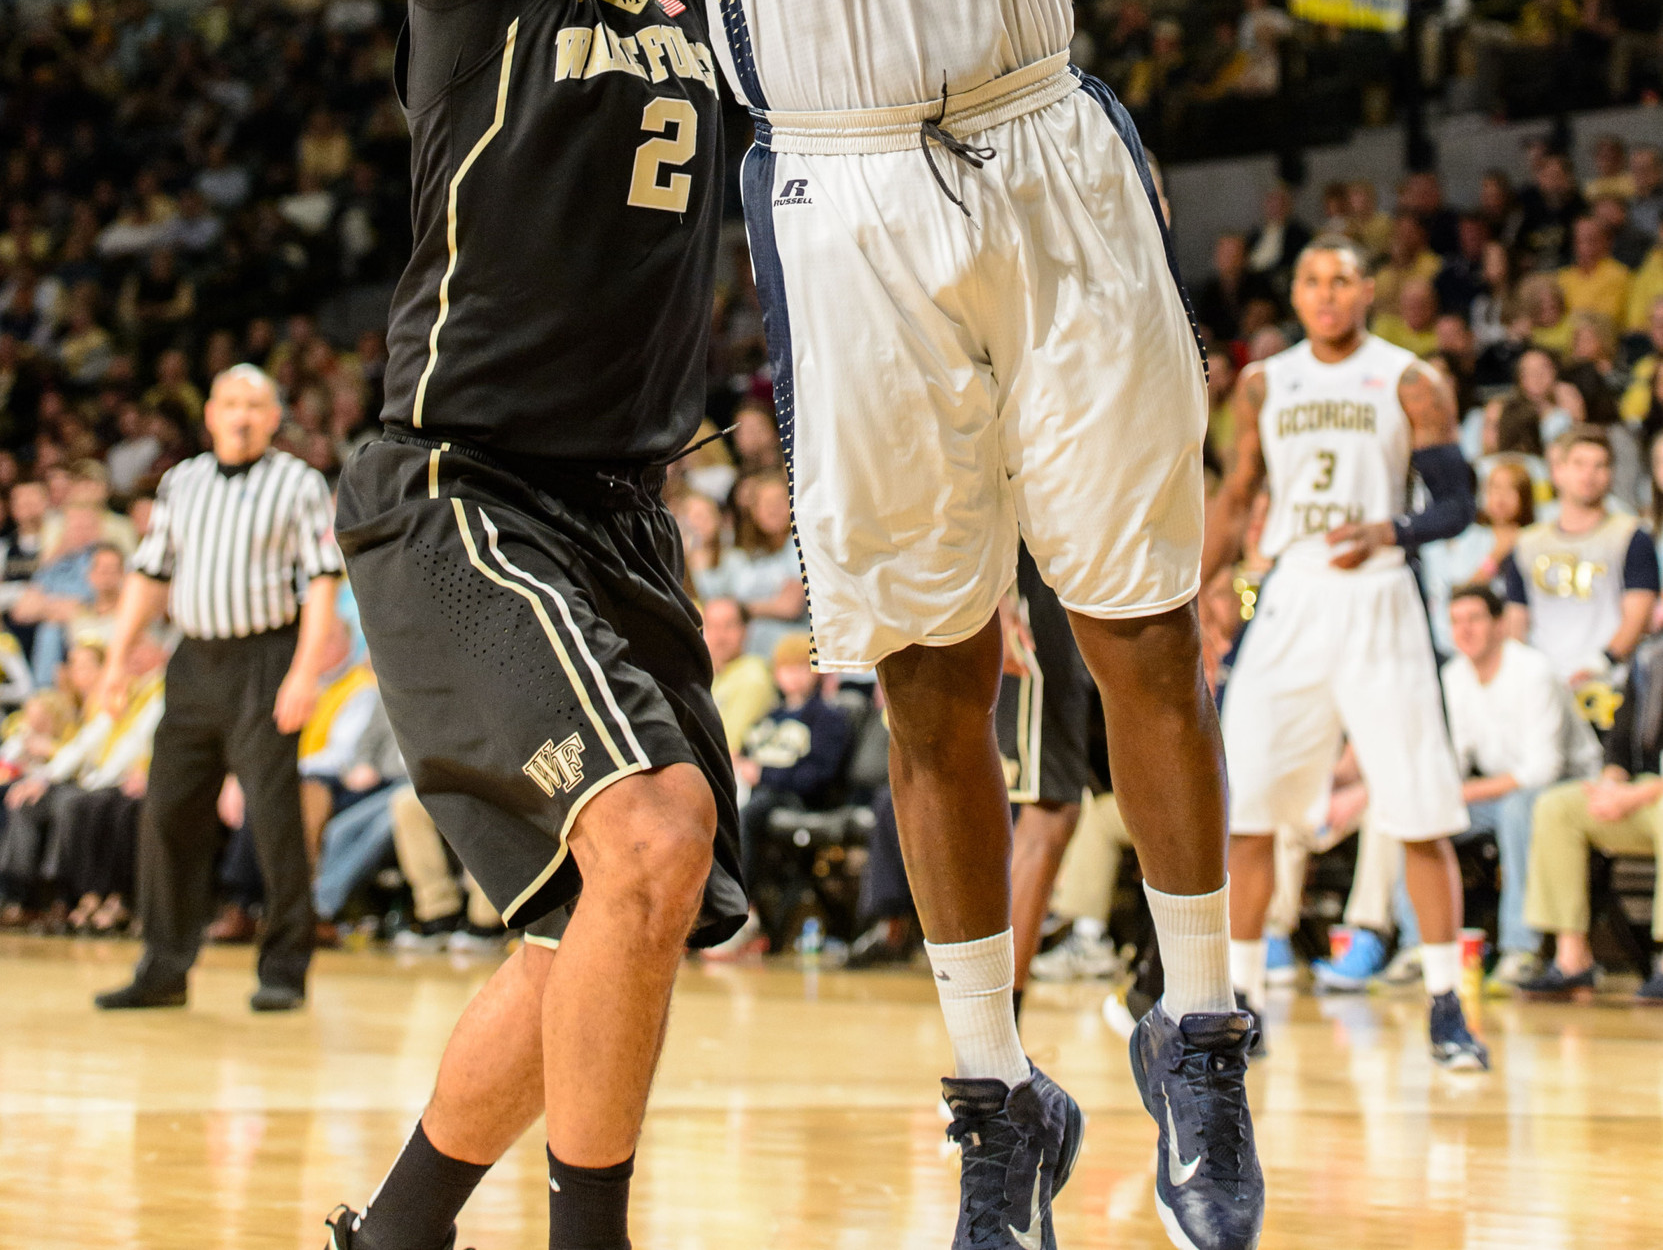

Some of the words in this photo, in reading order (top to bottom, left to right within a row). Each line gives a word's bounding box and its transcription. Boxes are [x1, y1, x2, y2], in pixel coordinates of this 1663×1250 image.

[627, 96, 698, 213] 2
[773, 197, 813, 208] RUSSELL
[1277, 399, 1378, 440] GEORGIA
[1312, 450, 1337, 492] 3
[521, 731, 586, 799] WF
